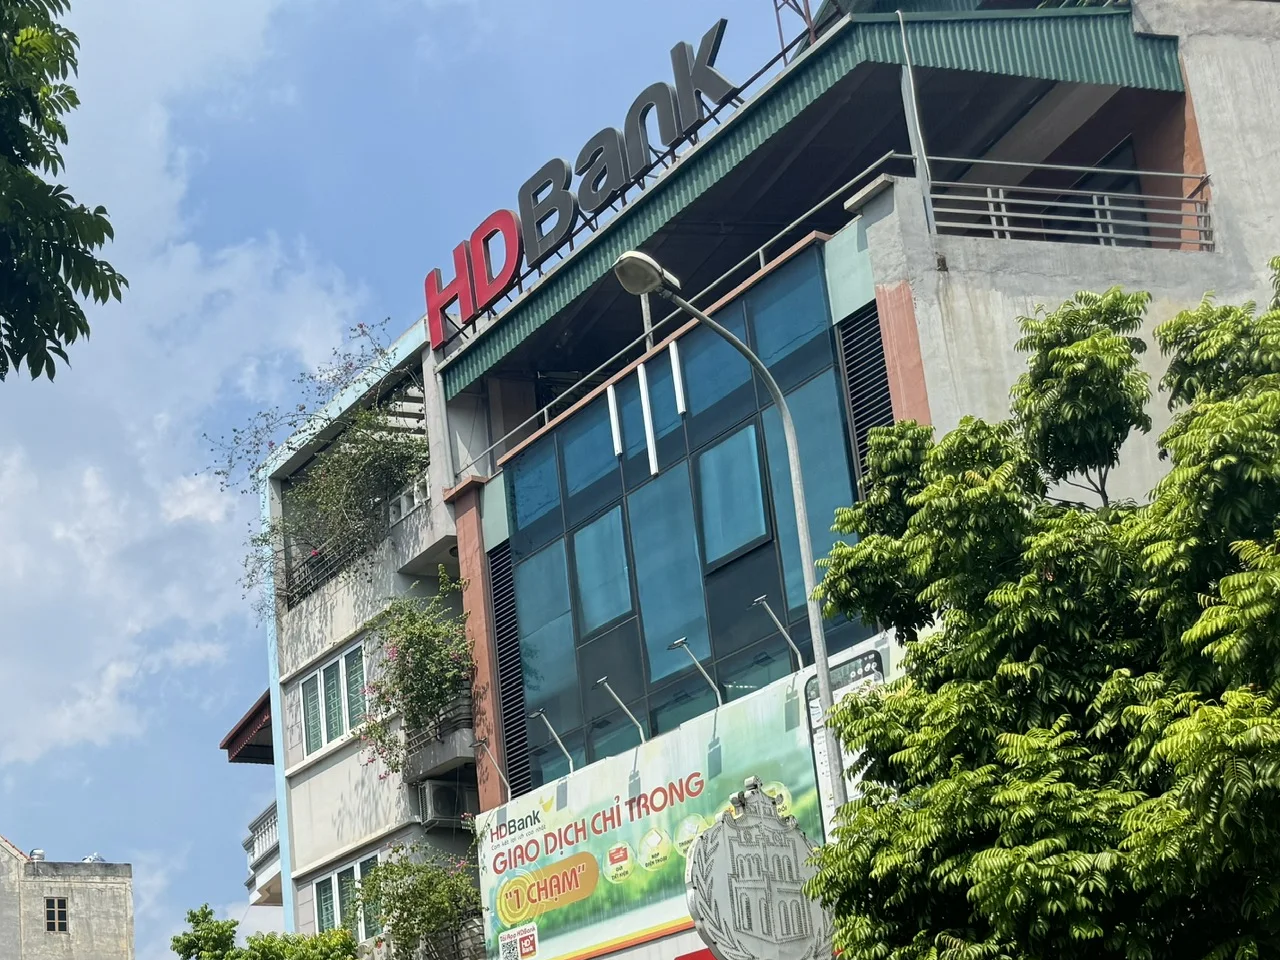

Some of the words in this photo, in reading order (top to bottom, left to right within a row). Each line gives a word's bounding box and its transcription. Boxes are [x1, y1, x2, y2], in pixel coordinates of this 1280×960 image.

[424, 18, 740, 351] HDBank
[490, 809, 541, 843] HDBank
[492, 839, 540, 875] GIAO
[543, 818, 587, 856] DỊCH
[591, 795, 622, 836] CHỈ
[625, 771, 705, 822] TRONG
